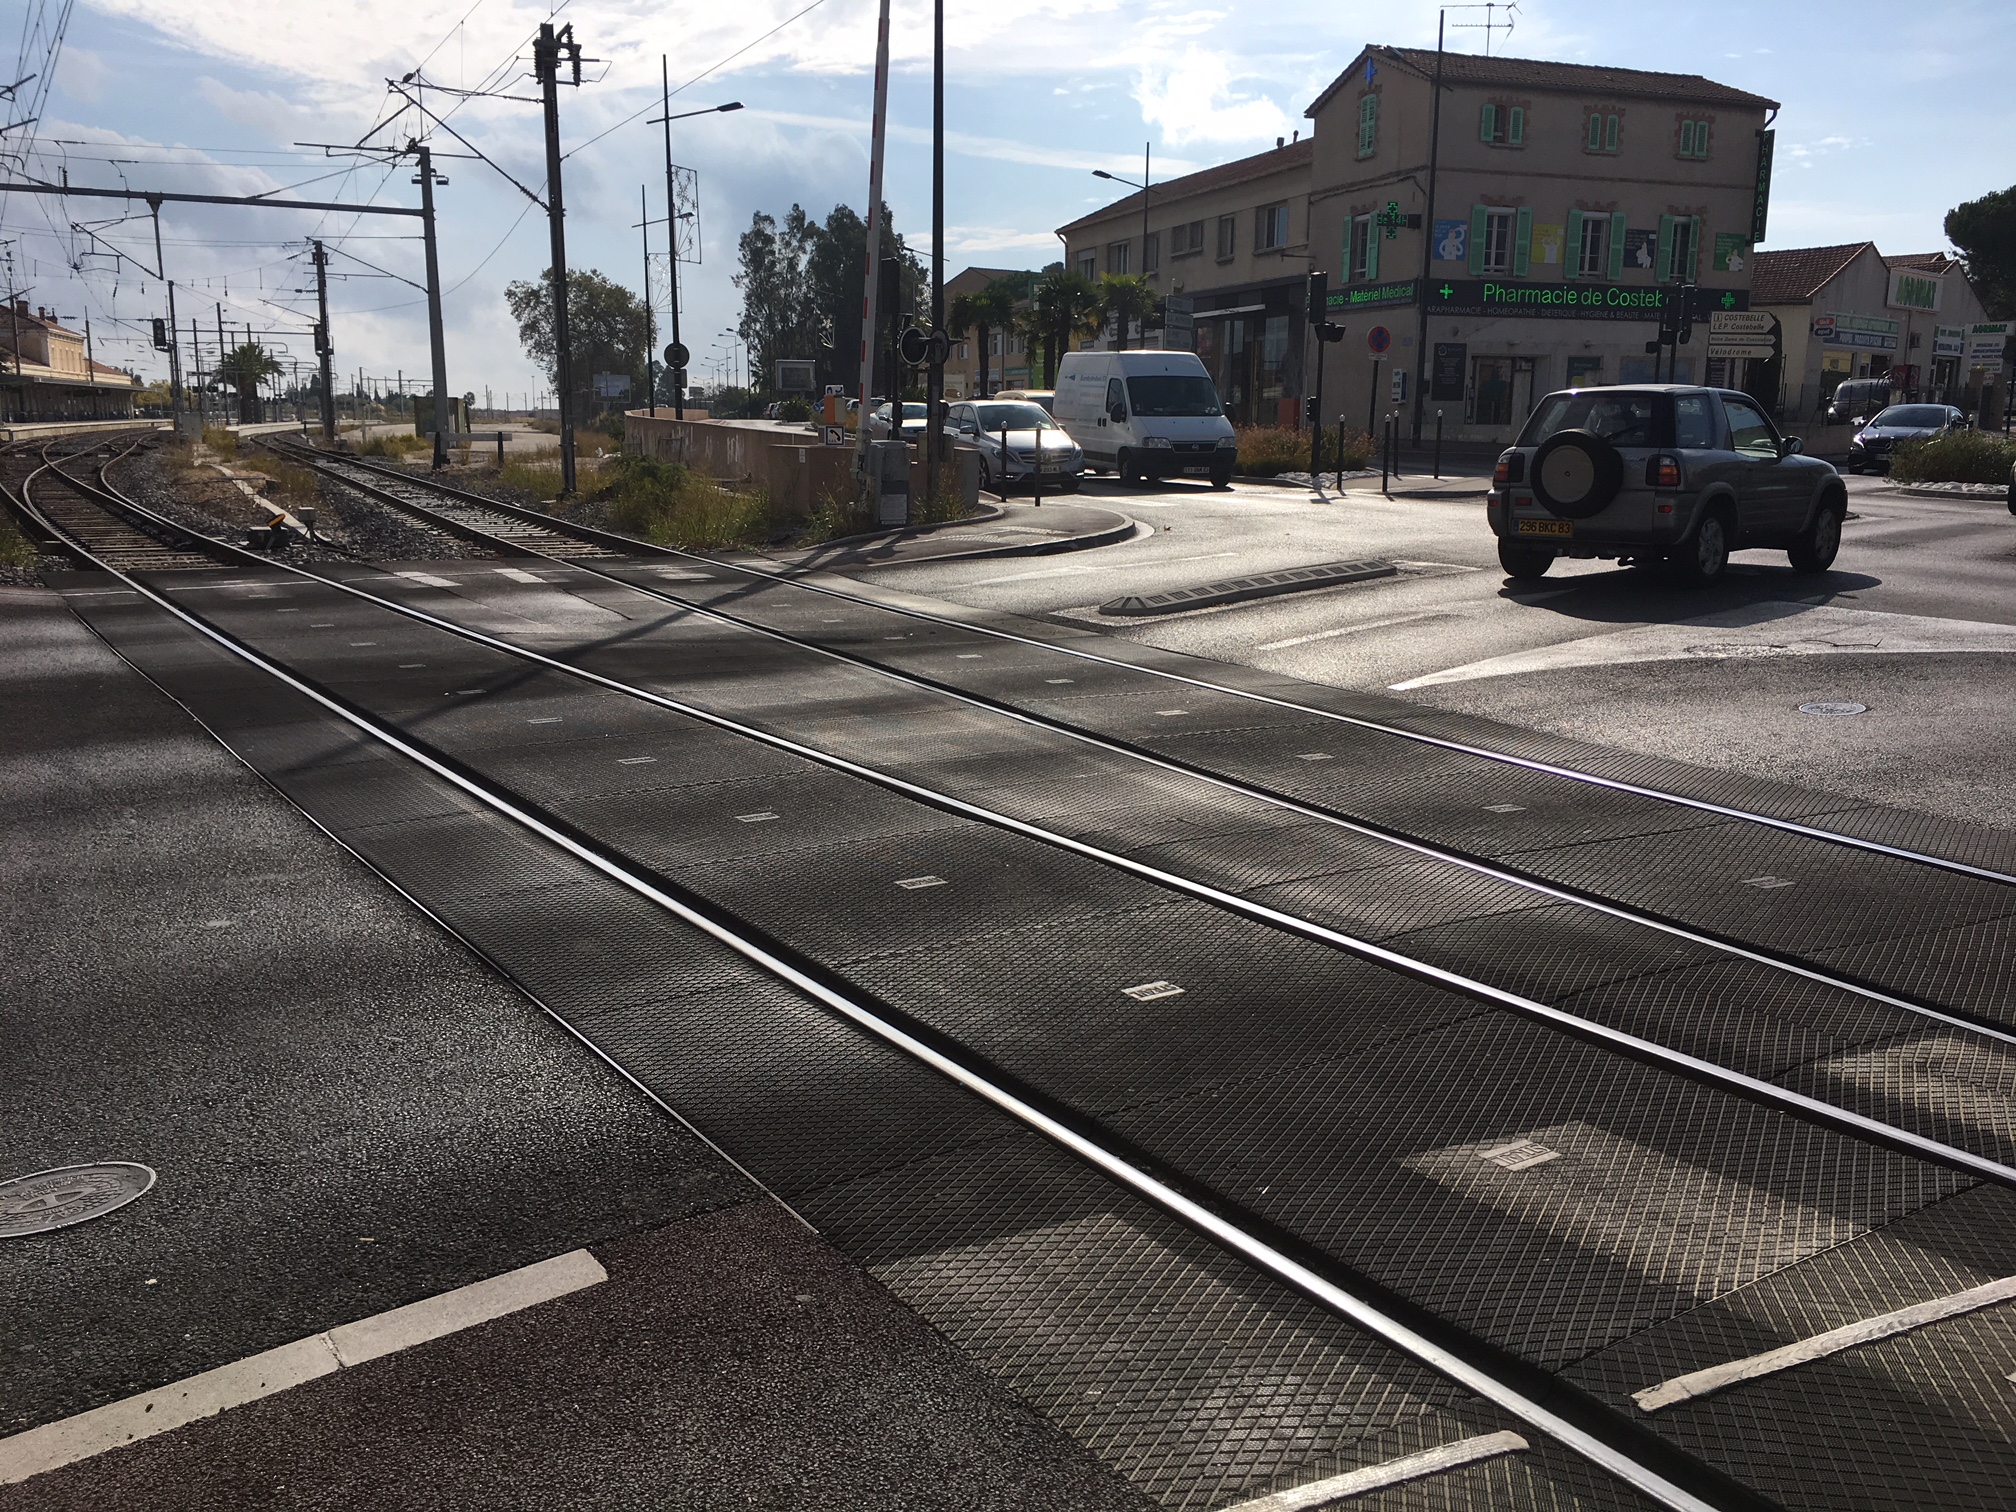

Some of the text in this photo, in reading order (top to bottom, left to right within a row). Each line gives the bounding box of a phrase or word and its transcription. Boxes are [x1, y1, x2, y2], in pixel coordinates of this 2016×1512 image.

[1753, 132, 1770, 242] PHARMACIE
[1350, 287, 1381, 303] Matériel
[1381, 282, 1414, 299] Médical
[1483, 283, 1577, 304] Pharmacie
[1581, 287, 1602, 305] de
[1724, 314, 1765, 322] COSTEBELLE
[1731, 323, 1765, 331] Costebelle
[1710, 348, 1752, 356] Vélodrome
[1519, 520, 1571, 534] 296 BKC 83
